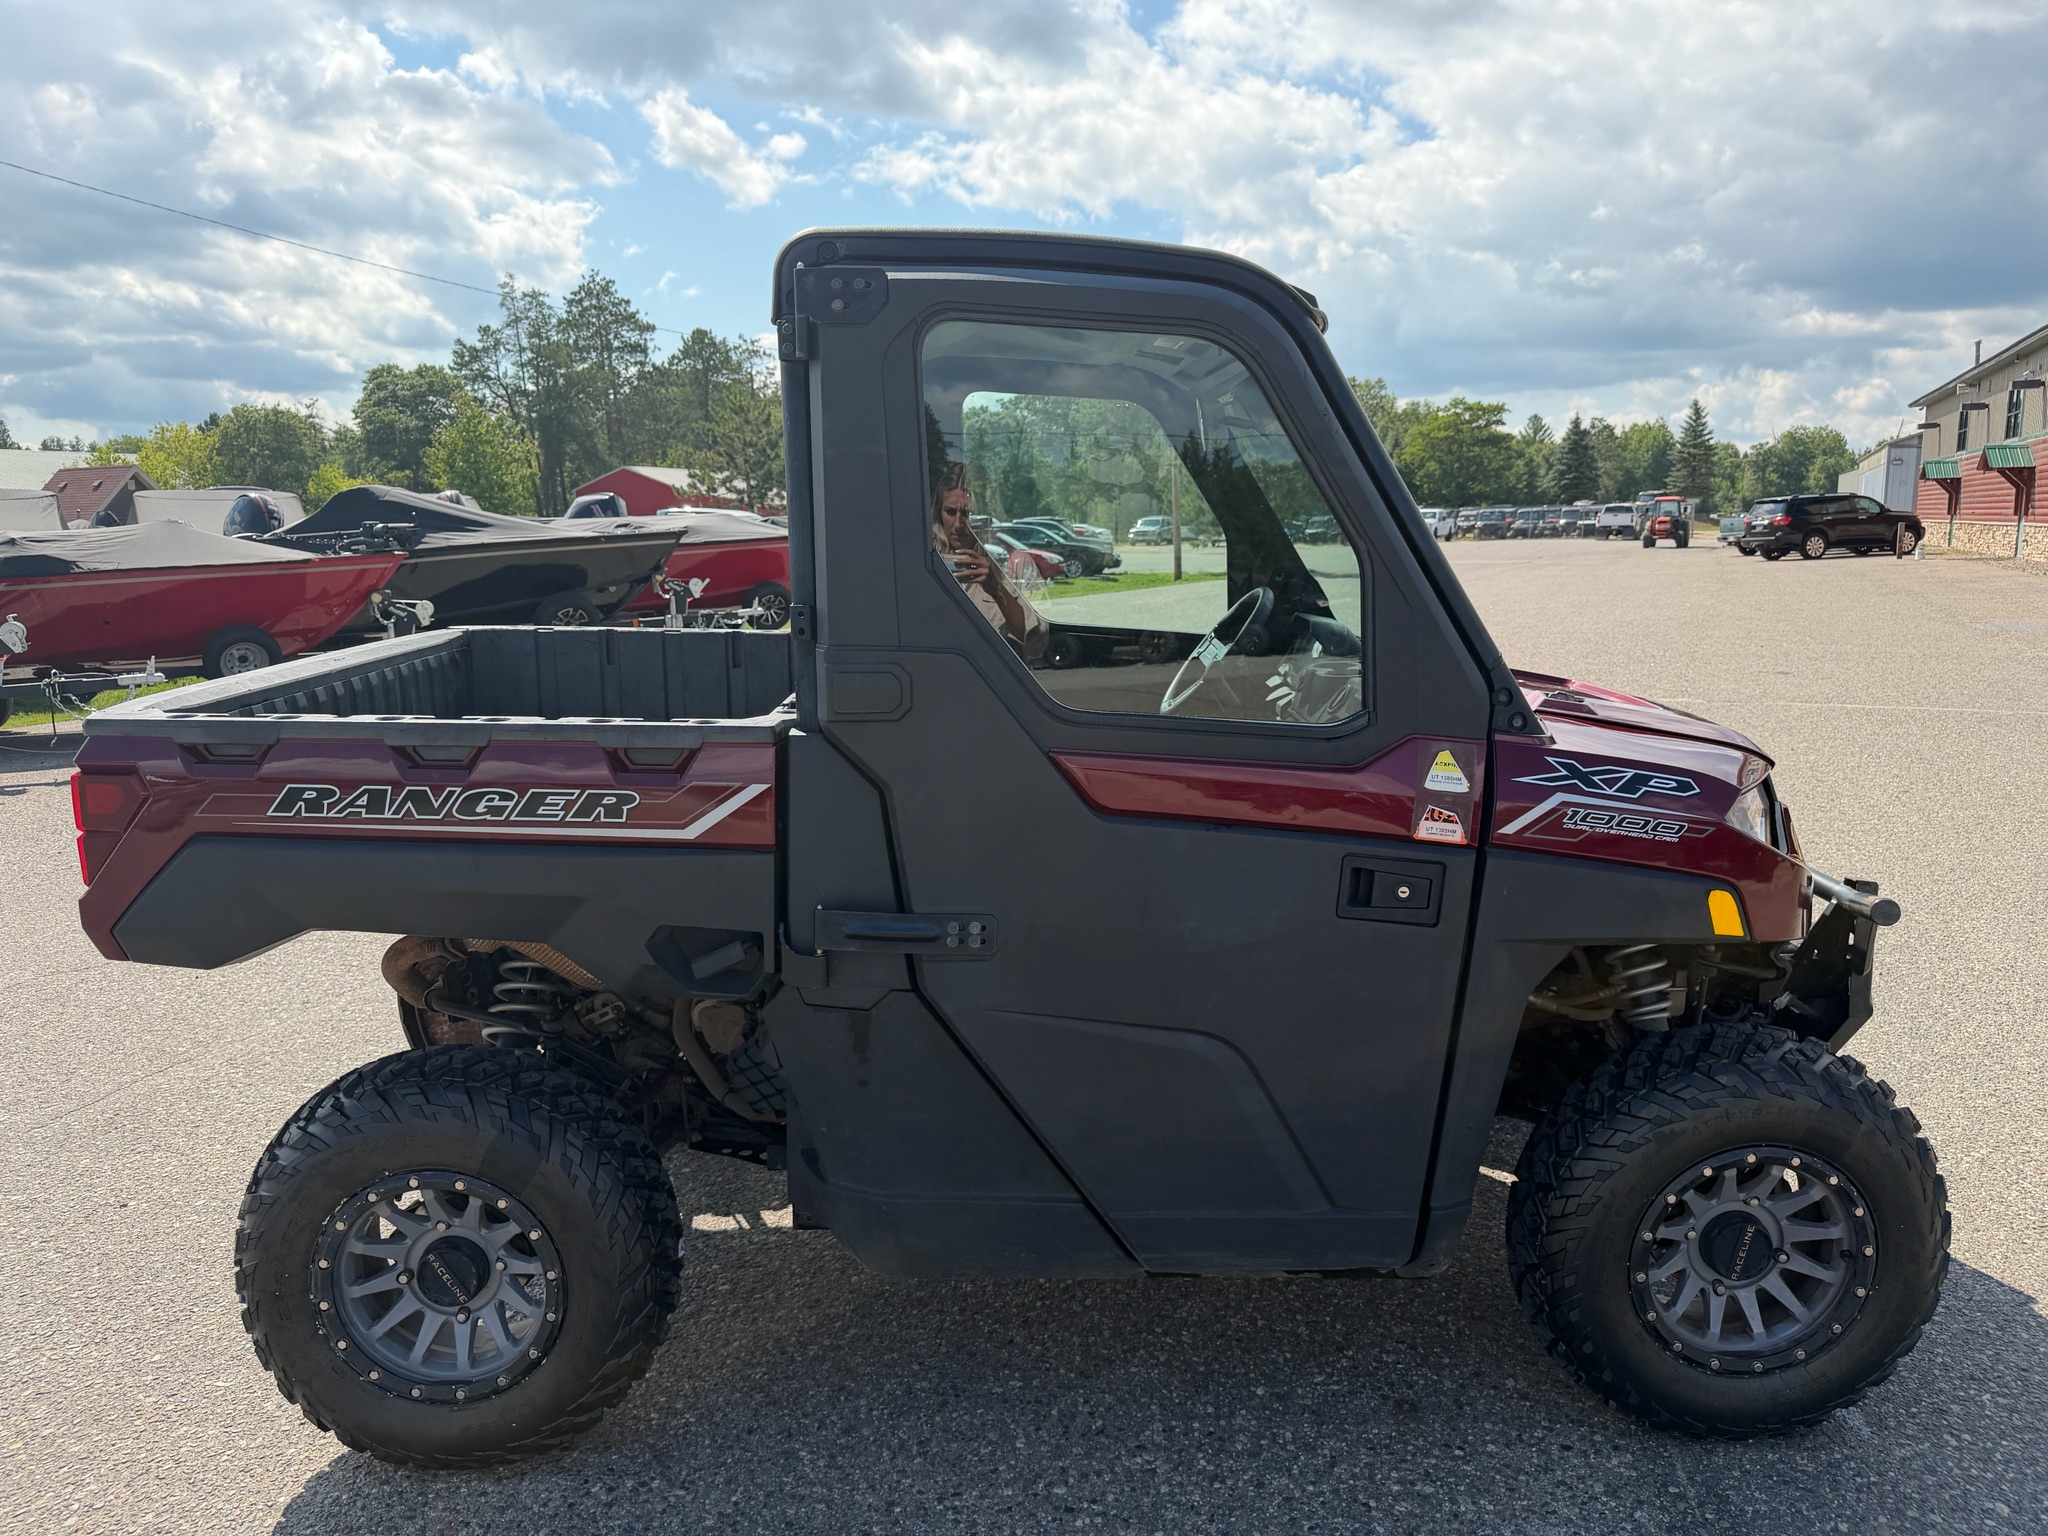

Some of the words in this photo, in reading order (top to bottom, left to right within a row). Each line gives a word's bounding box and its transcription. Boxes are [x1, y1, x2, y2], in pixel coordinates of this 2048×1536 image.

[1511, 756, 1701, 798] XP
[265, 783, 641, 823] RANGER
[1562, 807, 1689, 838] 1000
[1562, 823, 1593, 832] DUAL
[1594, 827, 1655, 840] OVERHEAD
[1654, 835, 1680, 843] CAM
[1731, 1224, 1756, 1280] RACELINE
[426, 1253, 468, 1304] RACELINE
